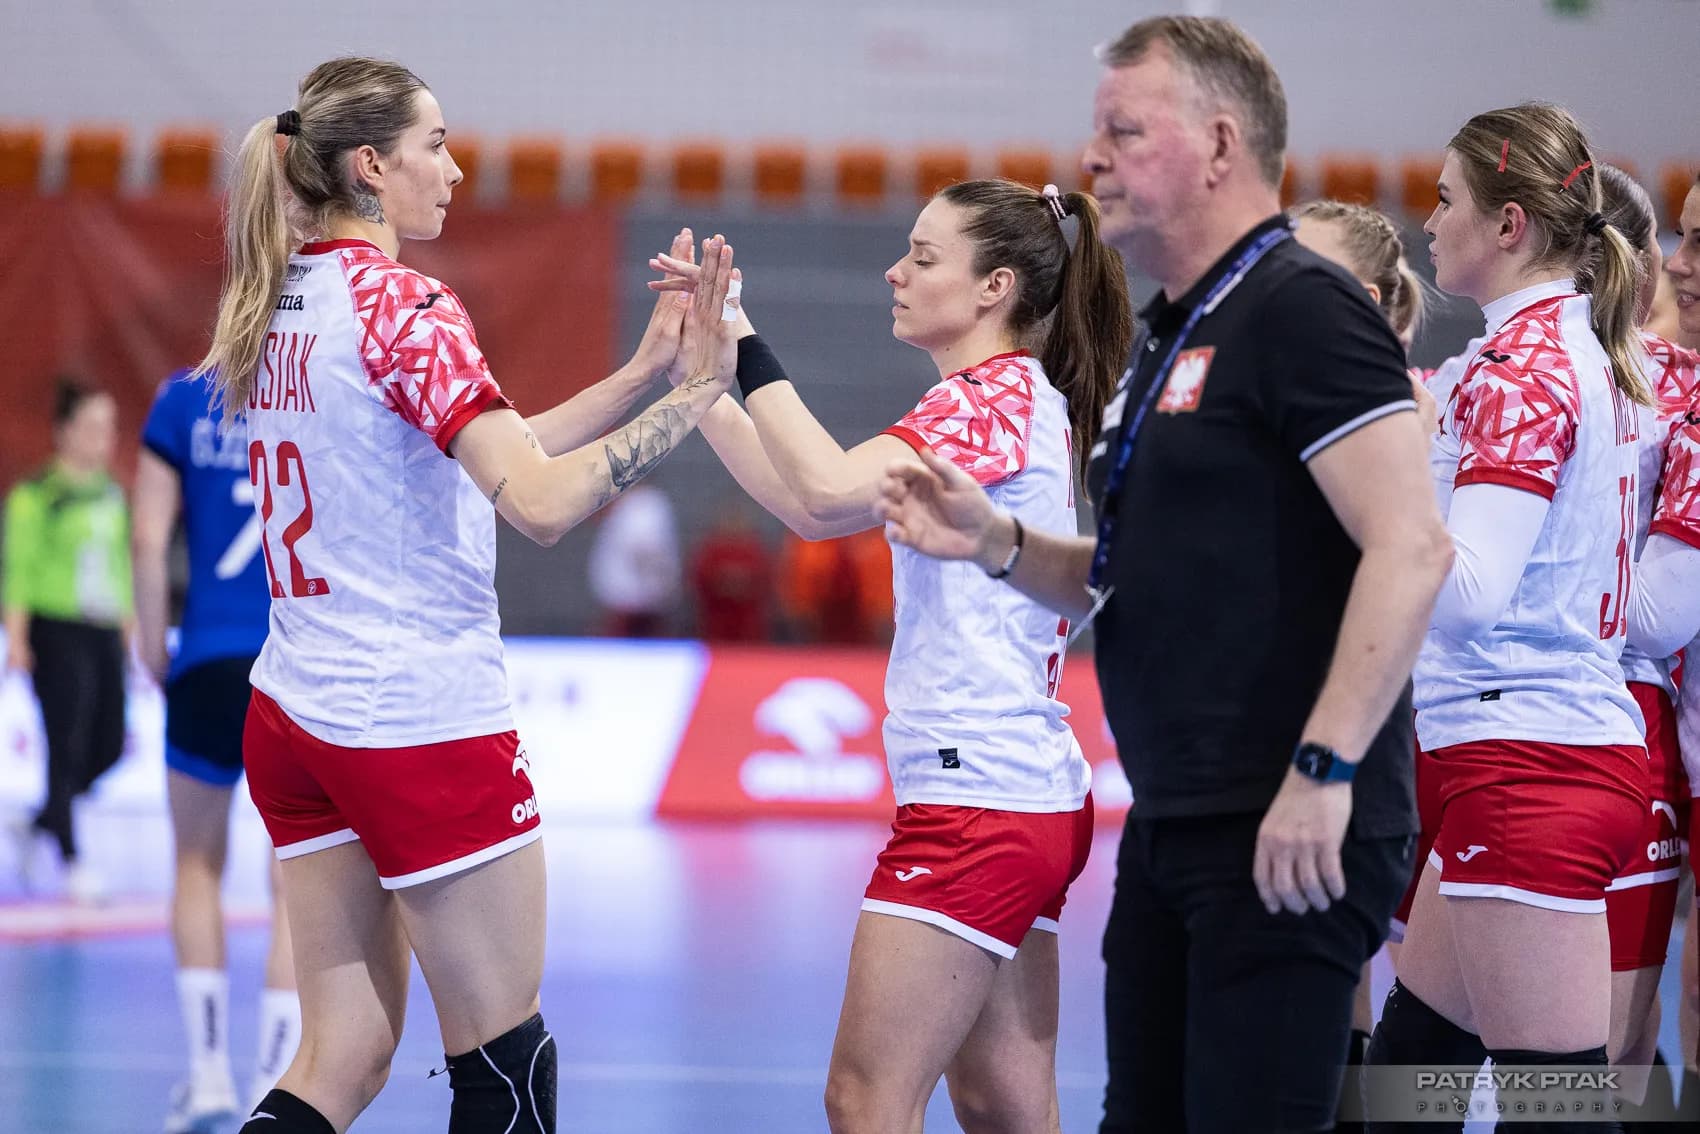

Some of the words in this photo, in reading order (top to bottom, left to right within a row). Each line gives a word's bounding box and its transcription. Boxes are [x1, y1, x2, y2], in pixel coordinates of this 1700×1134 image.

[275, 294, 304, 311] ma
[249, 440, 331, 599] 22
[511, 794, 538, 824] ORL
[1647, 837, 1682, 861] ORL
